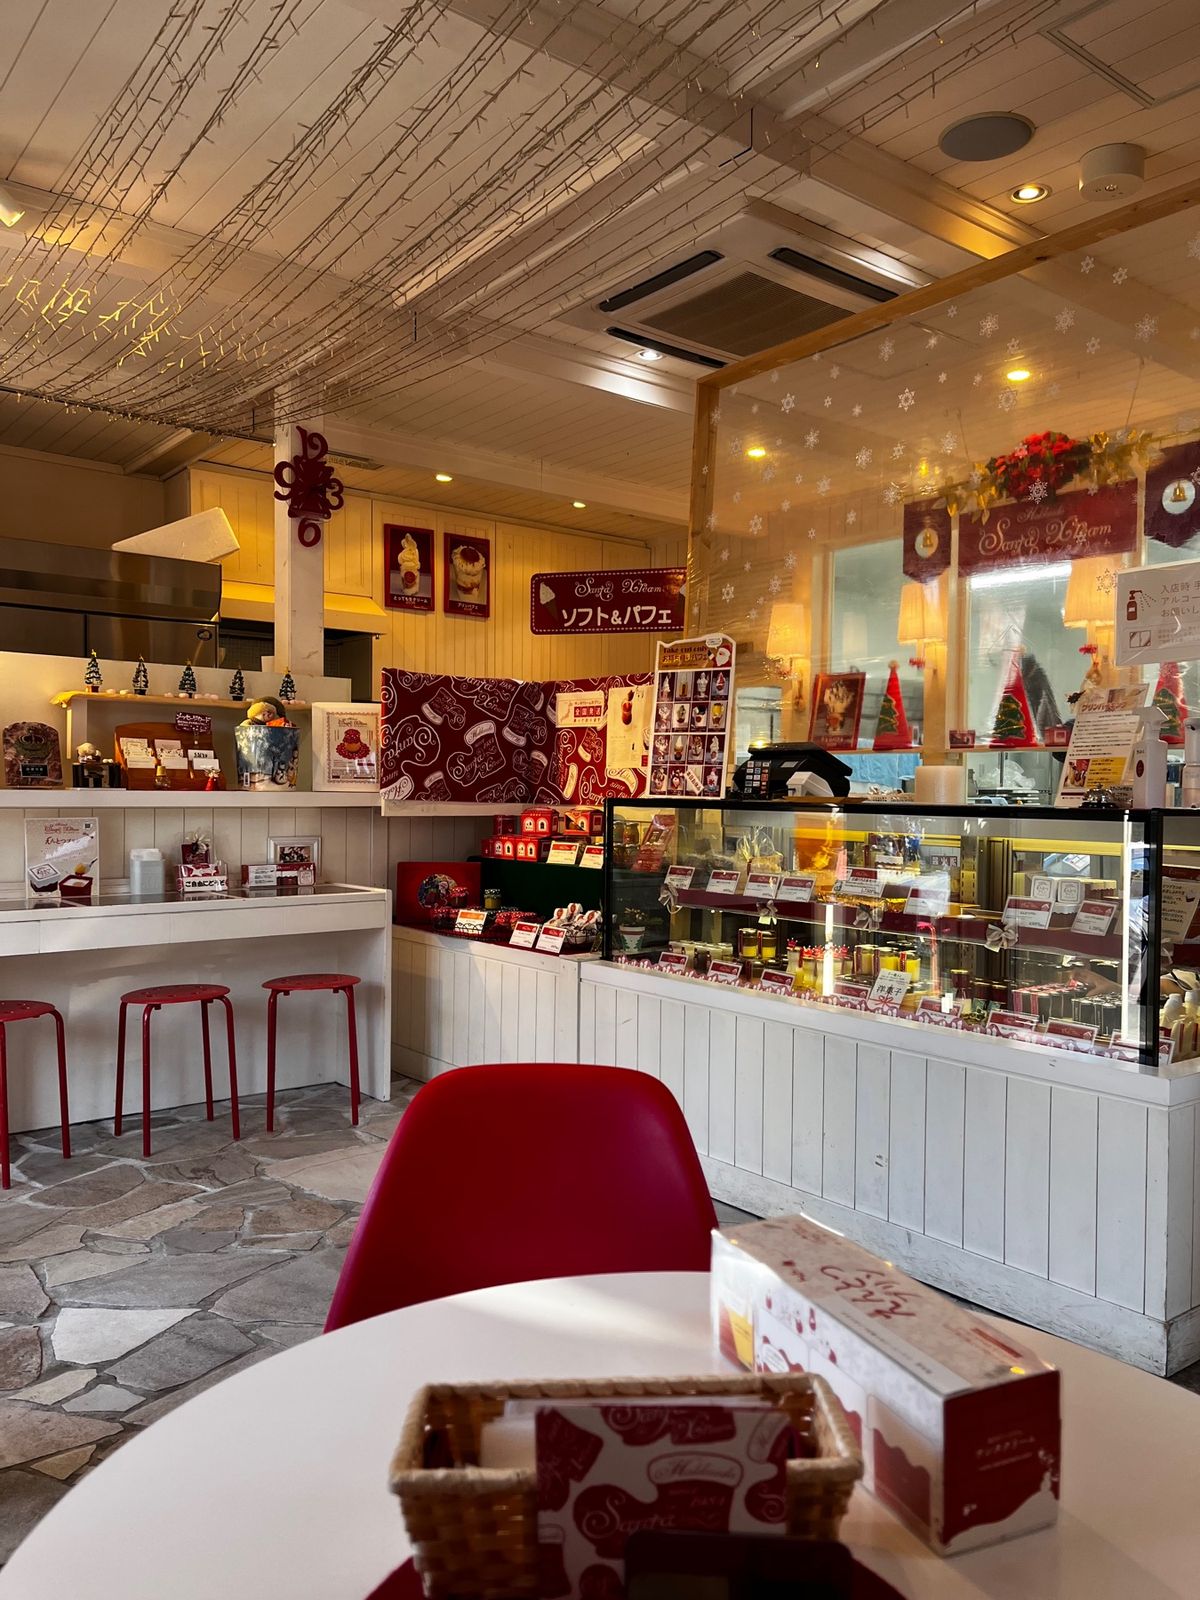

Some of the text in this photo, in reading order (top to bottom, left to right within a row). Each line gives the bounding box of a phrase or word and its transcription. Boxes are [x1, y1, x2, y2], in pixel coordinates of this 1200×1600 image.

[326, 477, 345, 511] 3
[297, 518, 322, 548] 6
[979, 517, 1042, 556] Santa
[574, 577, 614, 601] Santa
[1160, 583, 1190, 595] 入店時
[561, 605, 672, 627] ソフト&パフェ
[1160, 605, 1200, 617] お願いし
[876, 984, 902, 996] 洋菓子
